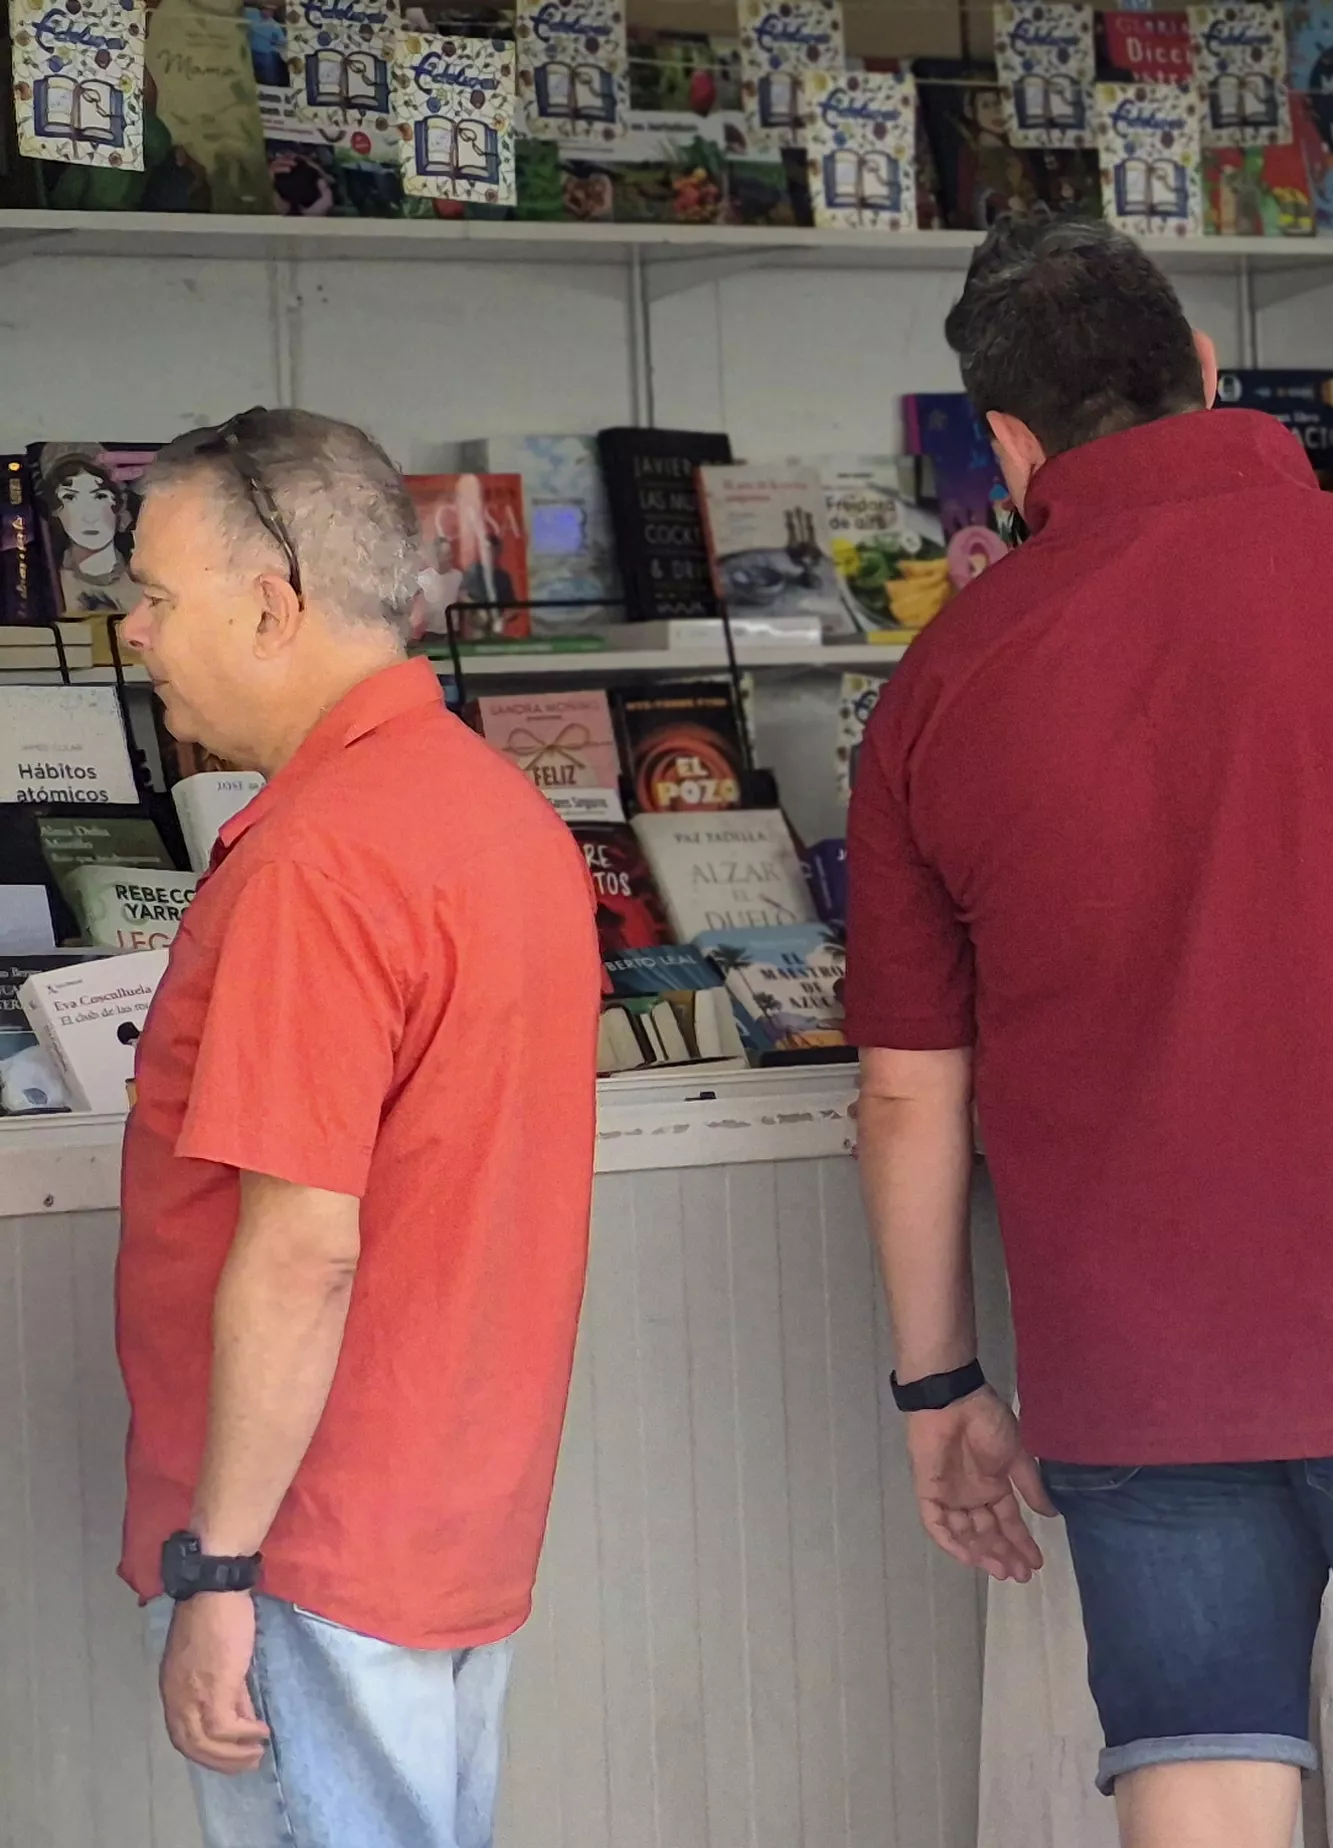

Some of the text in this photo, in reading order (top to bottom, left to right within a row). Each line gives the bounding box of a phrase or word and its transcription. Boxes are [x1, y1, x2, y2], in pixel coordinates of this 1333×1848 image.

[18, 763, 98, 780] Hábitos
[531, 765, 578, 786] FELIZ
[676, 757, 708, 778] EL
[16, 786, 109, 803] atómicos
[656, 780, 740, 806] POZO
[690, 861, 782, 885] ALZAR
[115, 884, 195, 904] REBECC
[659, 953, 697, 967] LEAL
[54, 1000, 78, 1012] Eva
